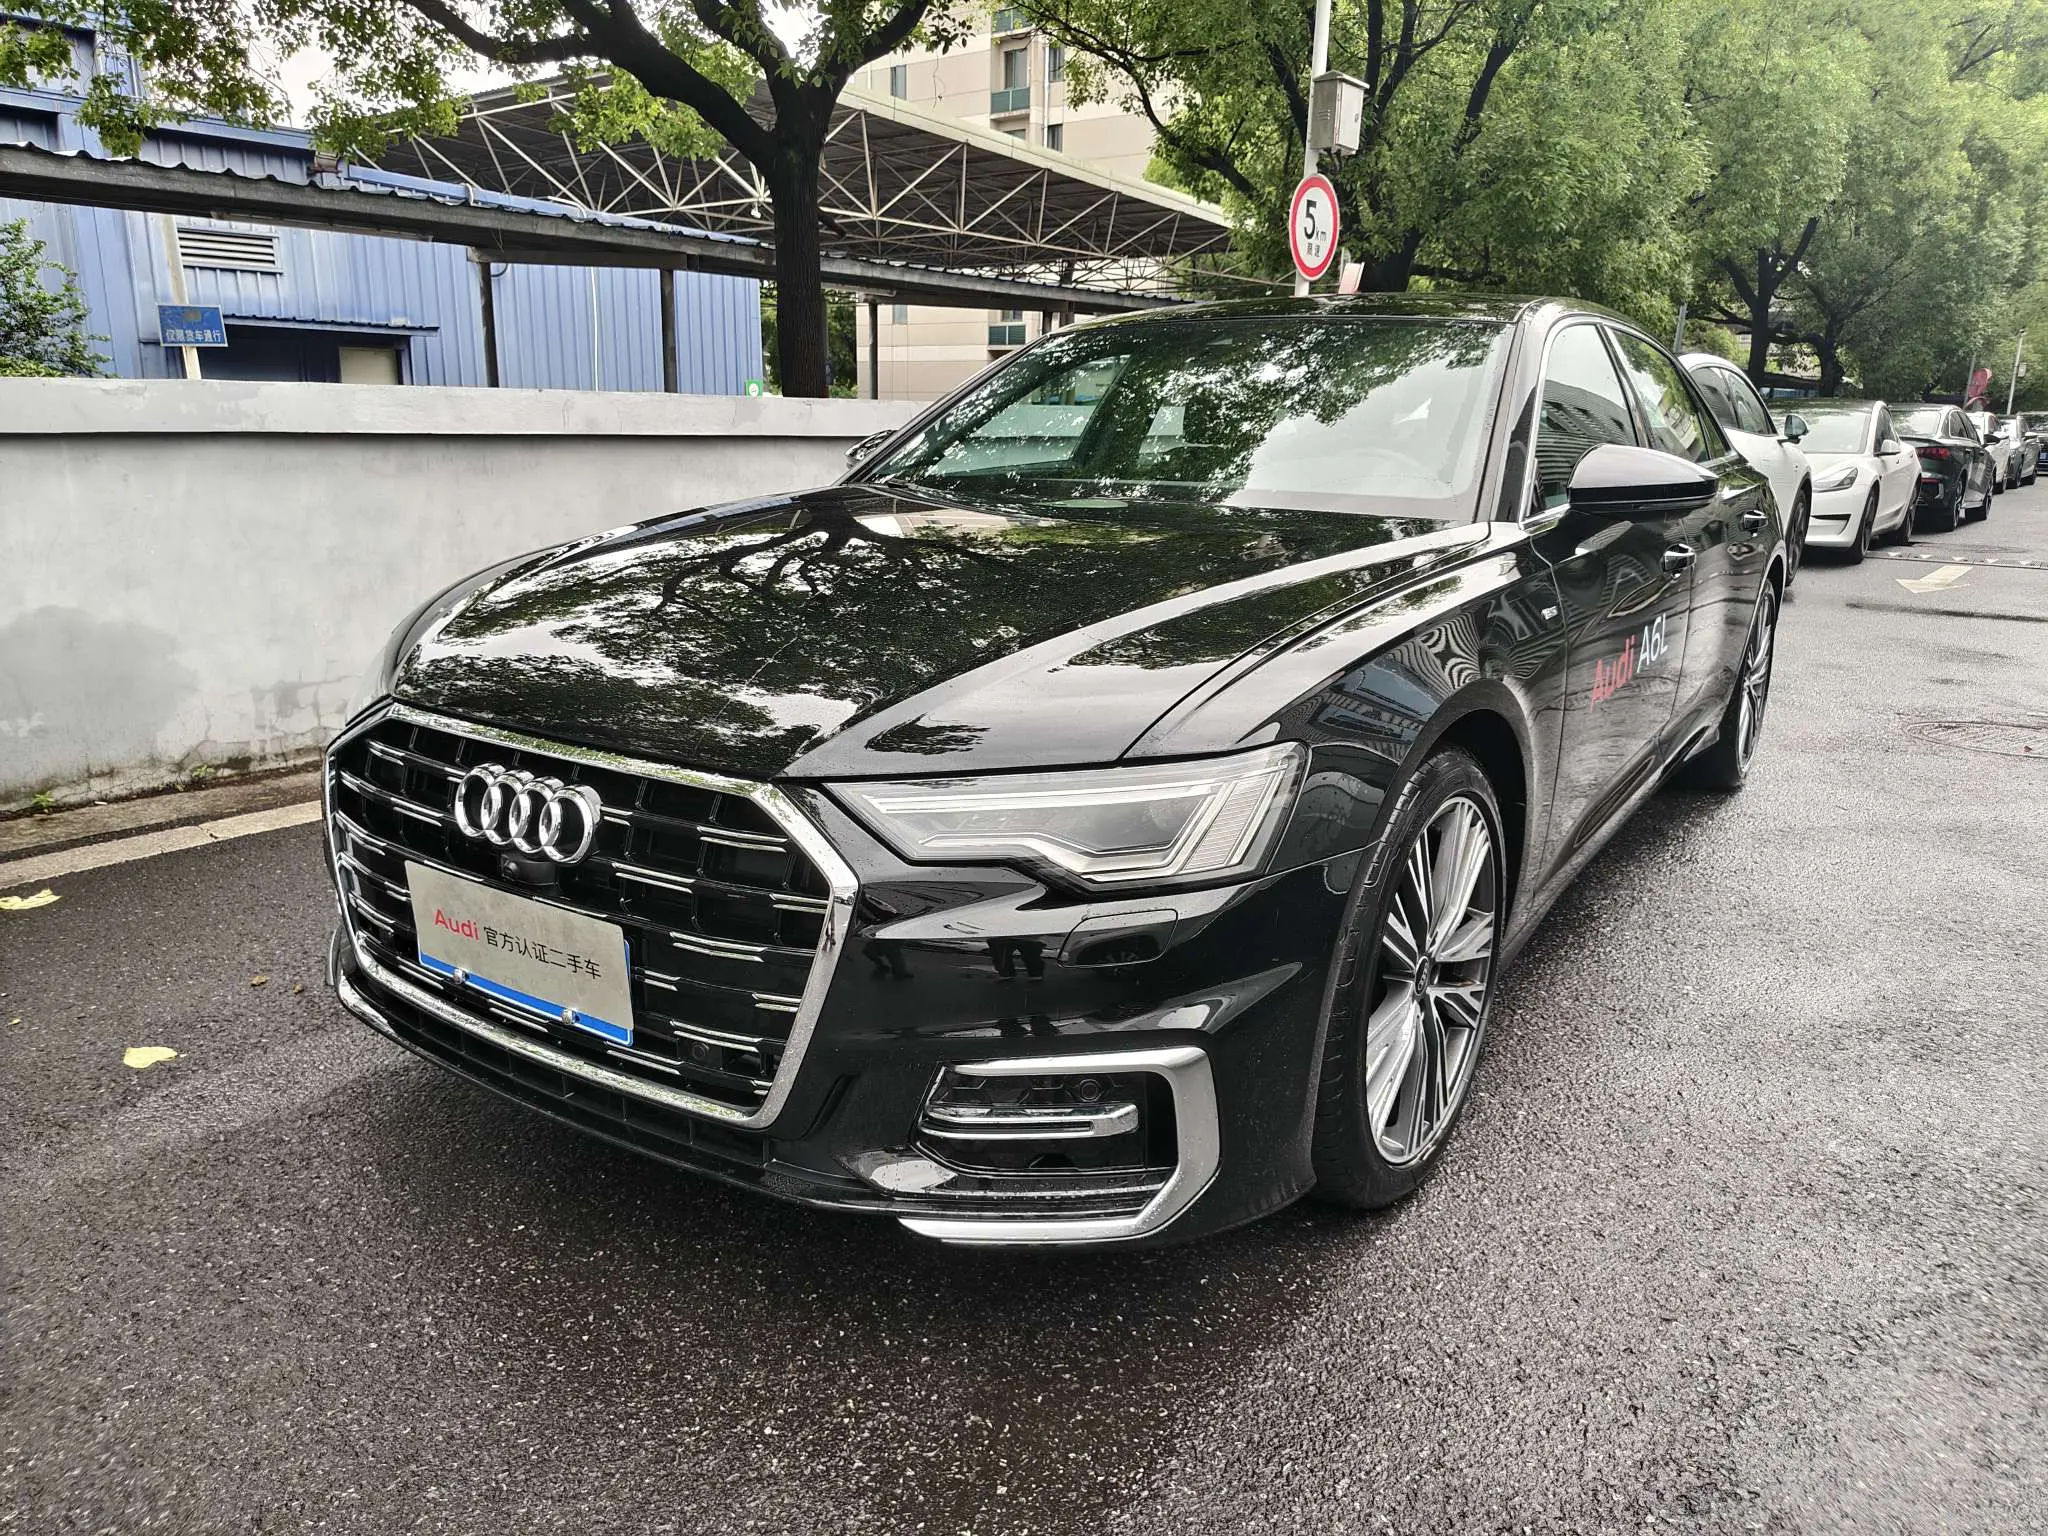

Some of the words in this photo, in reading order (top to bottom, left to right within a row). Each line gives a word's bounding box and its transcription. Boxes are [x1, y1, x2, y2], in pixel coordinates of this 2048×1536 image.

[1590, 635, 1636, 713] Audi
[1637, 612, 1668, 673] A6L
[434, 909, 480, 941] Audi
[484, 926, 601, 980] 官方认证二手车
